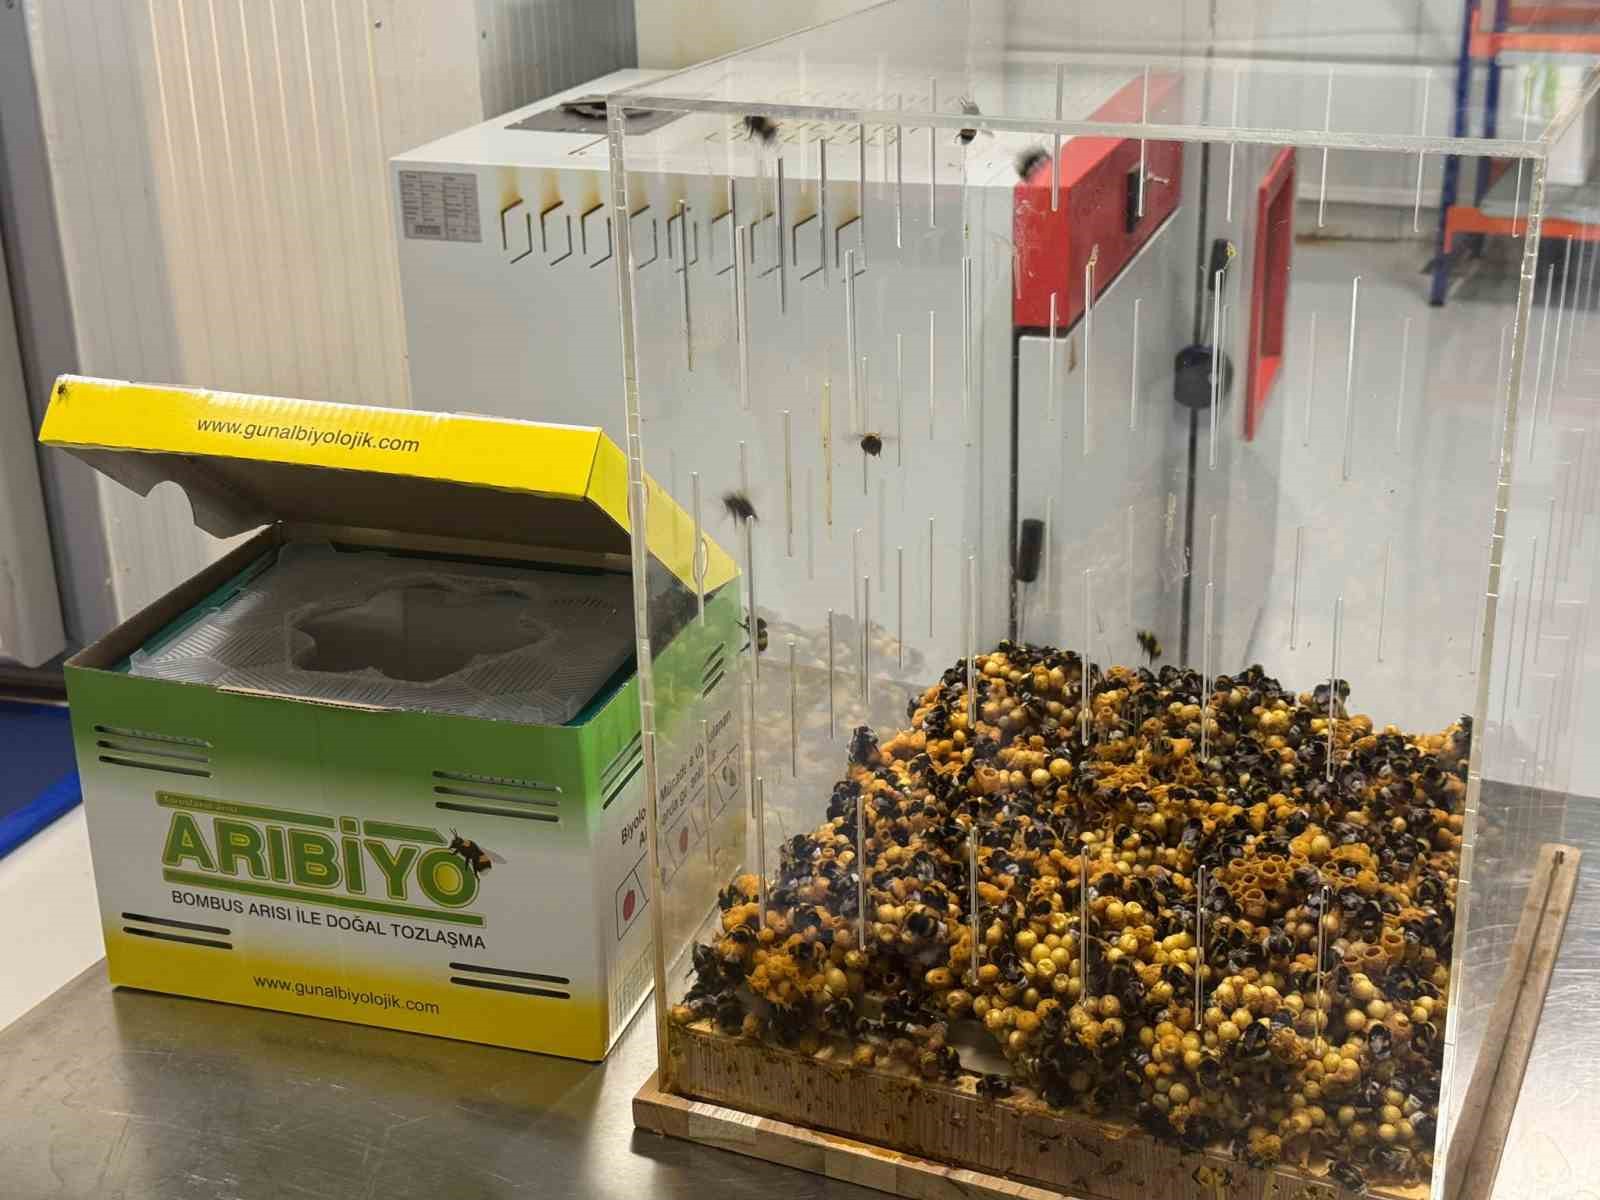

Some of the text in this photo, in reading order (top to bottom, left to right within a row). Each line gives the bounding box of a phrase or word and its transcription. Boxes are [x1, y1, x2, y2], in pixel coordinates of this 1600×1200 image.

[197, 418, 419, 452] www.gunalbiyolojik.com
[171, 890, 486, 950] BOMBUS ARISI İLE DOĞAL TOZLAŞMA
[253, 976, 439, 1014] www.gunalbiyolojik.com
